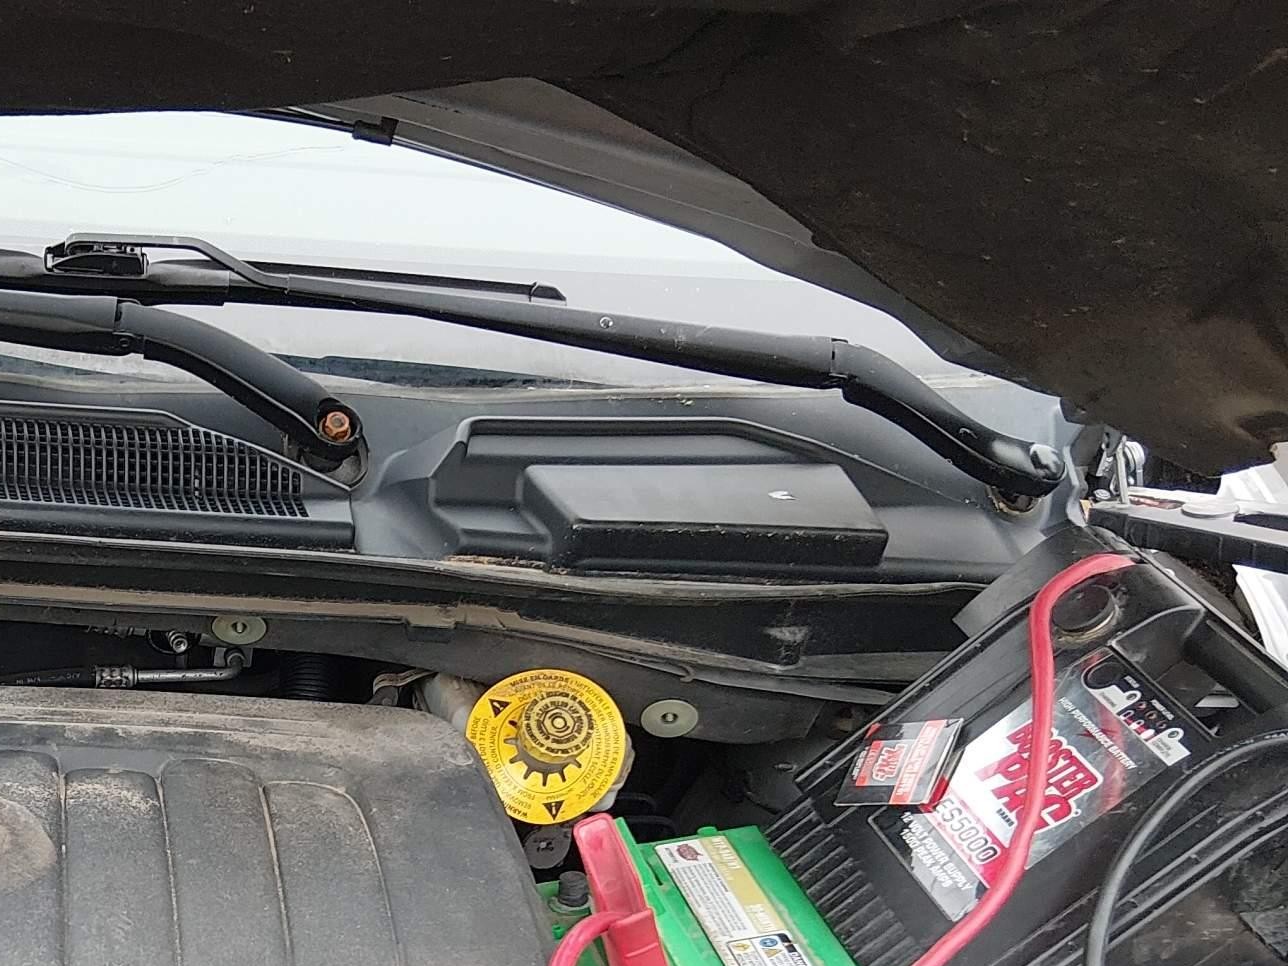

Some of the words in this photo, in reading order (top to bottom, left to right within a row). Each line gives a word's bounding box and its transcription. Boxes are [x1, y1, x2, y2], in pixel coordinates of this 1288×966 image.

[1072, 708, 1112, 748] PERFORMANCE
[1107, 743, 1138, 770] BATTERY
[900, 811, 913, 825] 12
[908, 815, 930, 843] VOLT
[923, 836, 951, 868] POWER
[944, 862, 974, 891] SUPPLY
[934, 798, 1000, 865] ES5000
[912, 843, 937, 869] PEAK
[930, 864, 955, 888] AMPS
